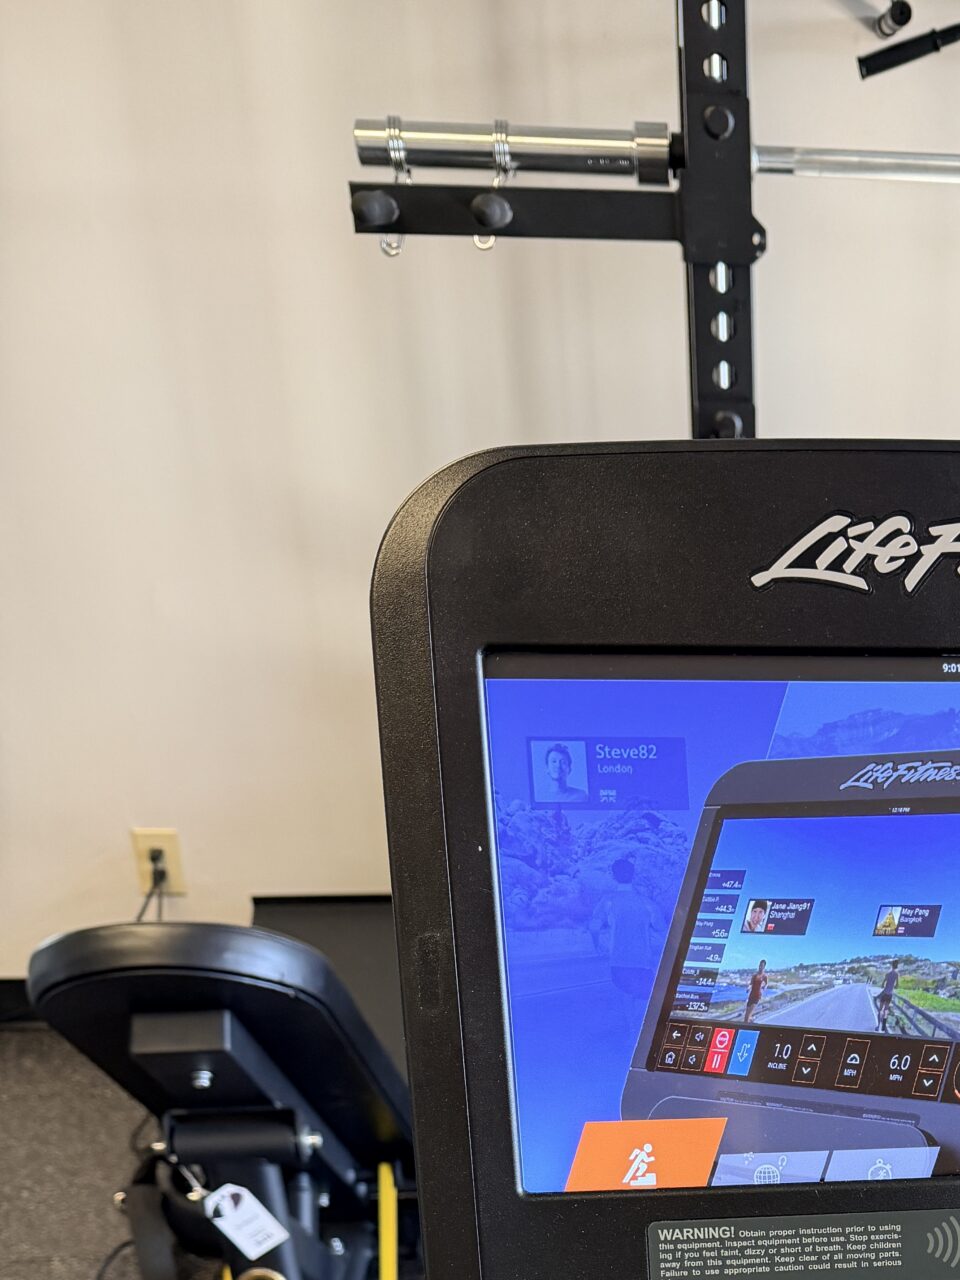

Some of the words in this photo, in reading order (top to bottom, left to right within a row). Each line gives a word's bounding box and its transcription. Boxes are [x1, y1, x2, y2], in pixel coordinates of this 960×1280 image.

[942, 663, 960, 672] 9:01
[596, 744, 657, 759] Steve82
[598, 764, 632, 774] London
[772, 902, 786, 910] Jane
[902, 908, 914, 917] May
[769, 911, 796, 920] Shanghai
[774, 1043, 792, 1059] 1.0
[890, 1054, 911, 1071] 6.0
[658, 1226, 734, 1240] WARNING!
[738, 1229, 765, 1237] Obtain
[768, 1230, 796, 1238] proper
[798, 1226, 842, 1235] instruction
[845, 1225, 864, 1234] prior
[878, 1224, 901, 1233] using
[658, 1242, 674, 1250] this
[676, 1240, 722, 1251] equipment.
[725, 1239, 755, 1248] Inspect
[757, 1237, 799, 1247] equipment
[849, 1234, 868, 1243] Stop
[870, 1232, 901, 1240] exercis-
[659, 1252, 672, 1261] ing
[684, 1252, 699, 1260] you
[720, 1249, 741, 1258] faint,
[744, 1248, 765, 1257] dizzy
[780, 1246, 801, 1254] short
[815, 1244, 843, 1252] breath.
[846, 1243, 866, 1252] Keep
[869, 1241, 901, 1250] children
[660, 1262, 680, 1270] away
[726, 1257, 771, 1267] equipment.
[774, 1256, 795, 1265] Keep
[798, 1254, 818, 1262] clear
[846, 1252, 875, 1262] moving
[878, 1251, 902, 1260] parts.
[660, 1269, 688, 1277] Failure
[723, 1265, 770, 1276] appropriate
[774, 1264, 804, 1272] caution
[808, 1262, 830, 1270] could
[834, 1261, 857, 1269] result
[872, 1259, 902, 1267] serious
